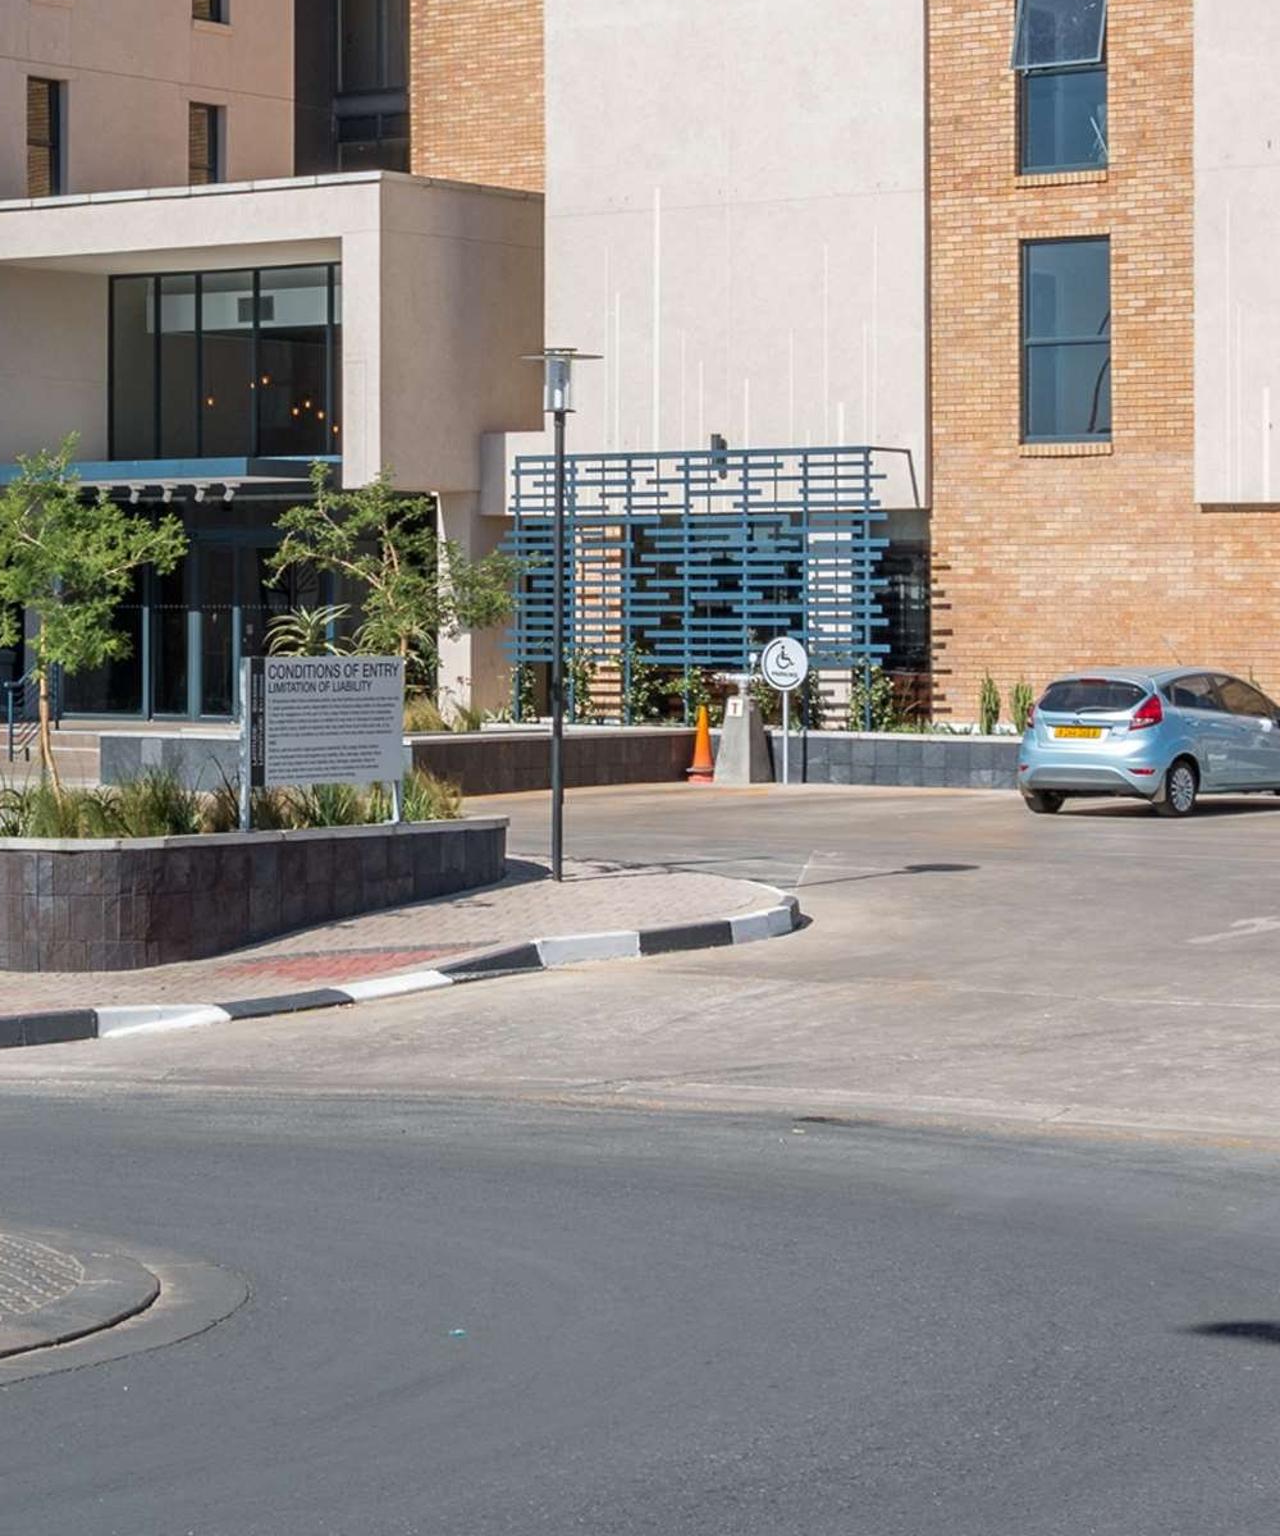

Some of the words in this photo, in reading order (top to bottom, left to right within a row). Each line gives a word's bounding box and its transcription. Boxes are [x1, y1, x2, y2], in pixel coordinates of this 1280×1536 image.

[268, 664, 340, 680] CONDITIONS
[344, 663, 360, 678] OF
[363, 663, 398, 678] ENTRY
[268, 681, 317, 694] LIMITATION
[318, 681, 330, 693] OF
[332, 680, 372, 693] LIABILITY
